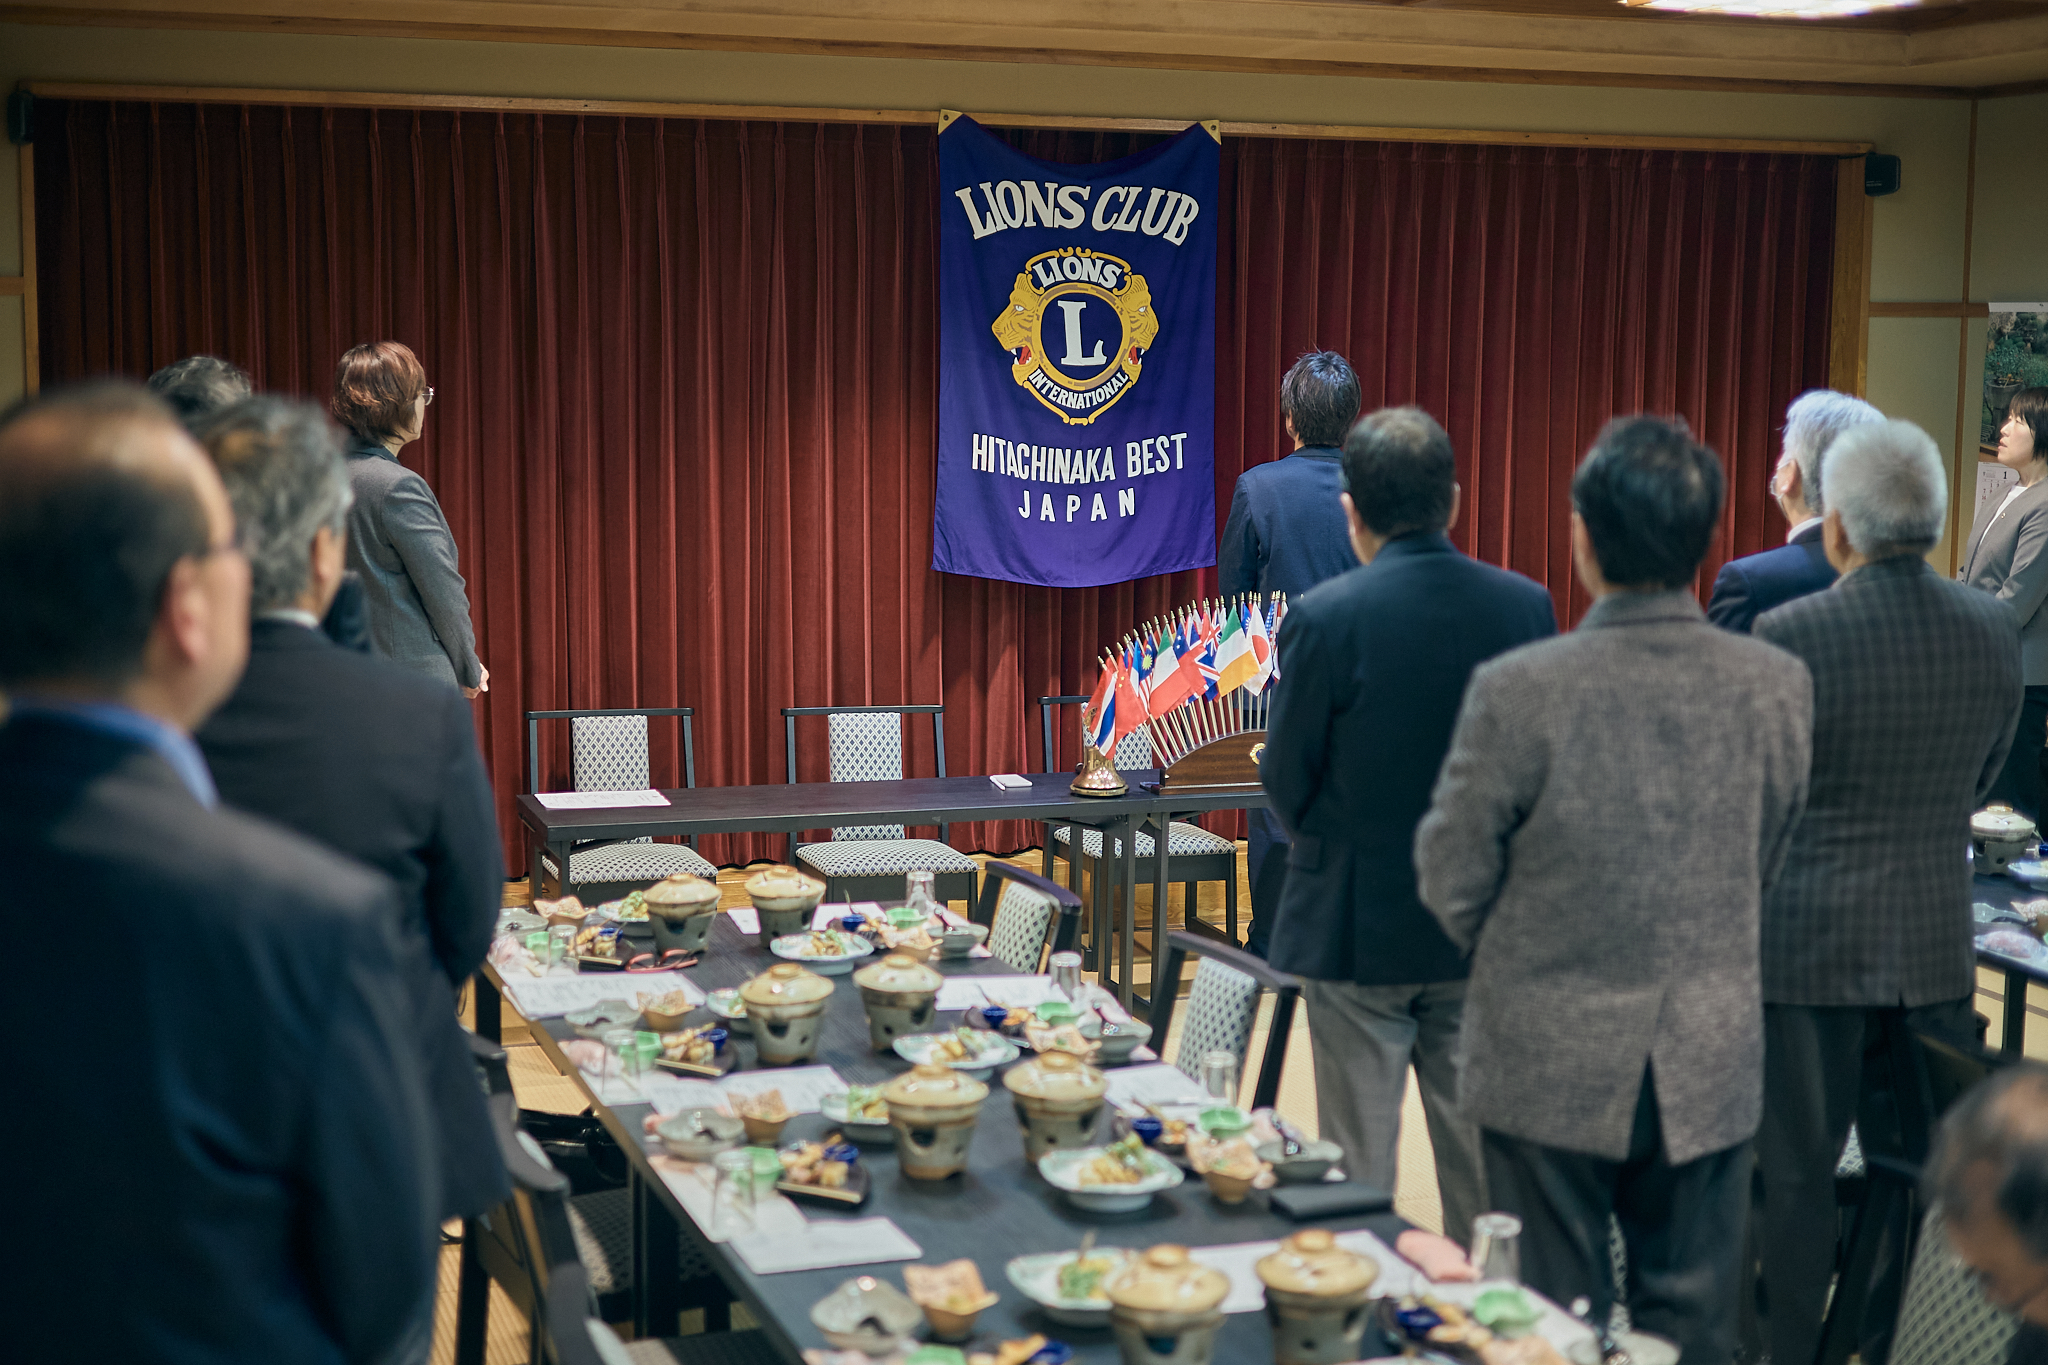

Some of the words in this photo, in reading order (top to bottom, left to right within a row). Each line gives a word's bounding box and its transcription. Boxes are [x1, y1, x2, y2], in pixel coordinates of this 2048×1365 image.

[954, 180, 1091, 240] LIONS
[1091, 185, 1200, 246] CLUB
[1032, 256, 1122, 289] LIONS
[1057, 300, 1107, 366] L
[1028, 368, 1129, 409] INTERNATIONAL
[972, 433, 1116, 484] HITACHINAKA
[1126, 432, 1188, 478] BEST
[1018, 487, 1135, 522] JAPAN
